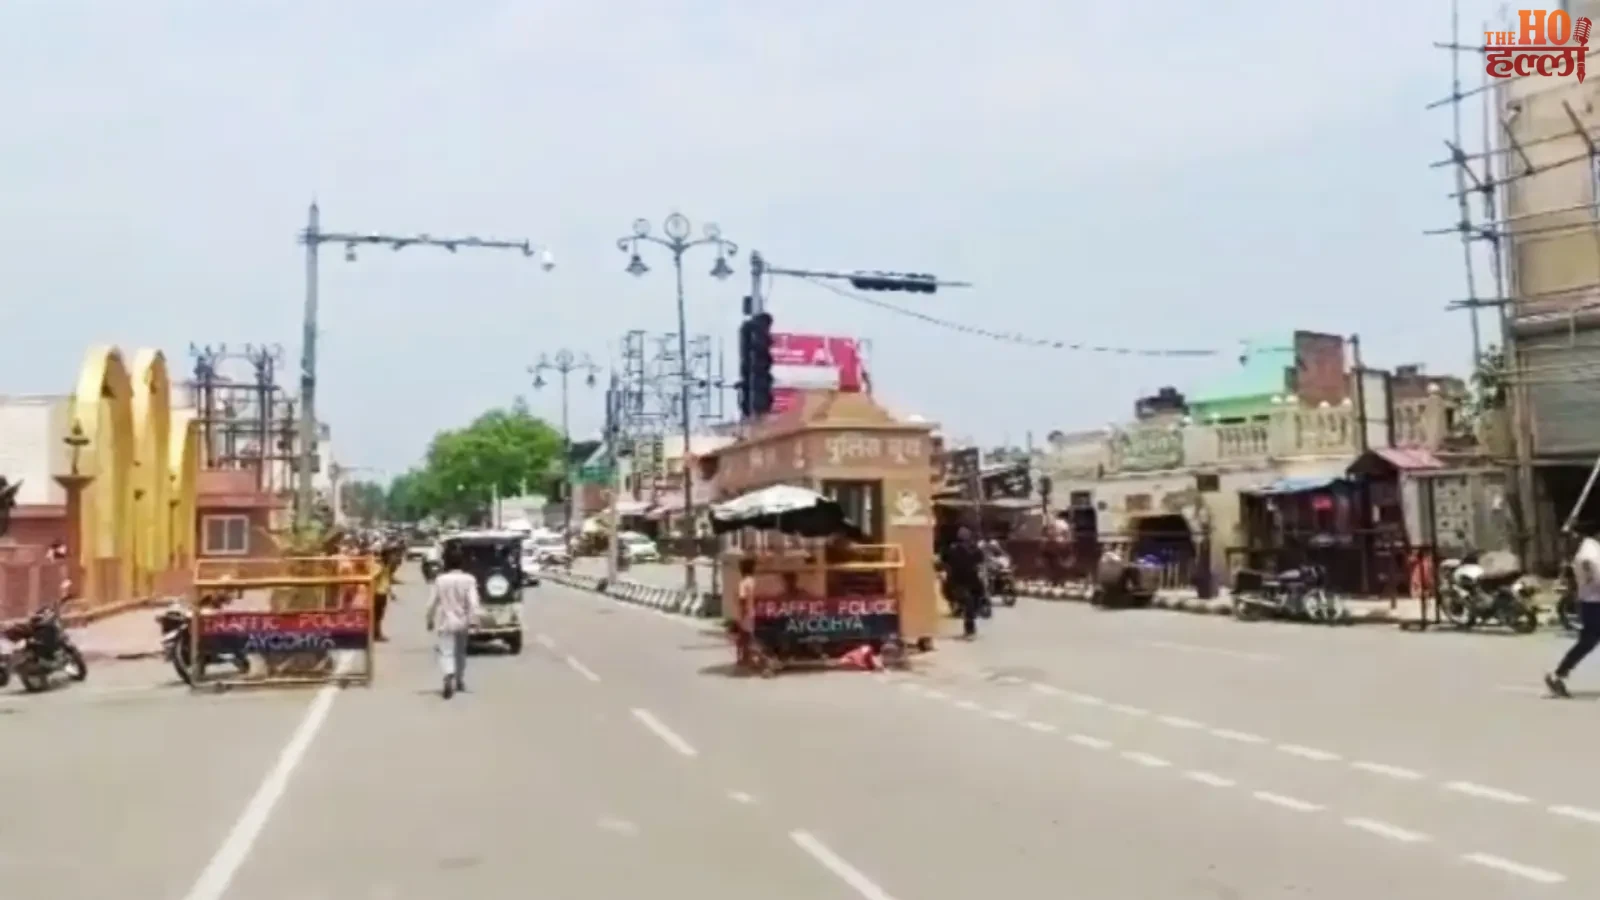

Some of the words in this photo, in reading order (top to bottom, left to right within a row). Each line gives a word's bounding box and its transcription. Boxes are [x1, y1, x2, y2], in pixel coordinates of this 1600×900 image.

[755, 600, 825, 617] TRAFFIC
[838, 599, 896, 615] POLICE
[203, 615, 280, 632] TRAFFIC
[299, 612, 366, 628] POLICE
